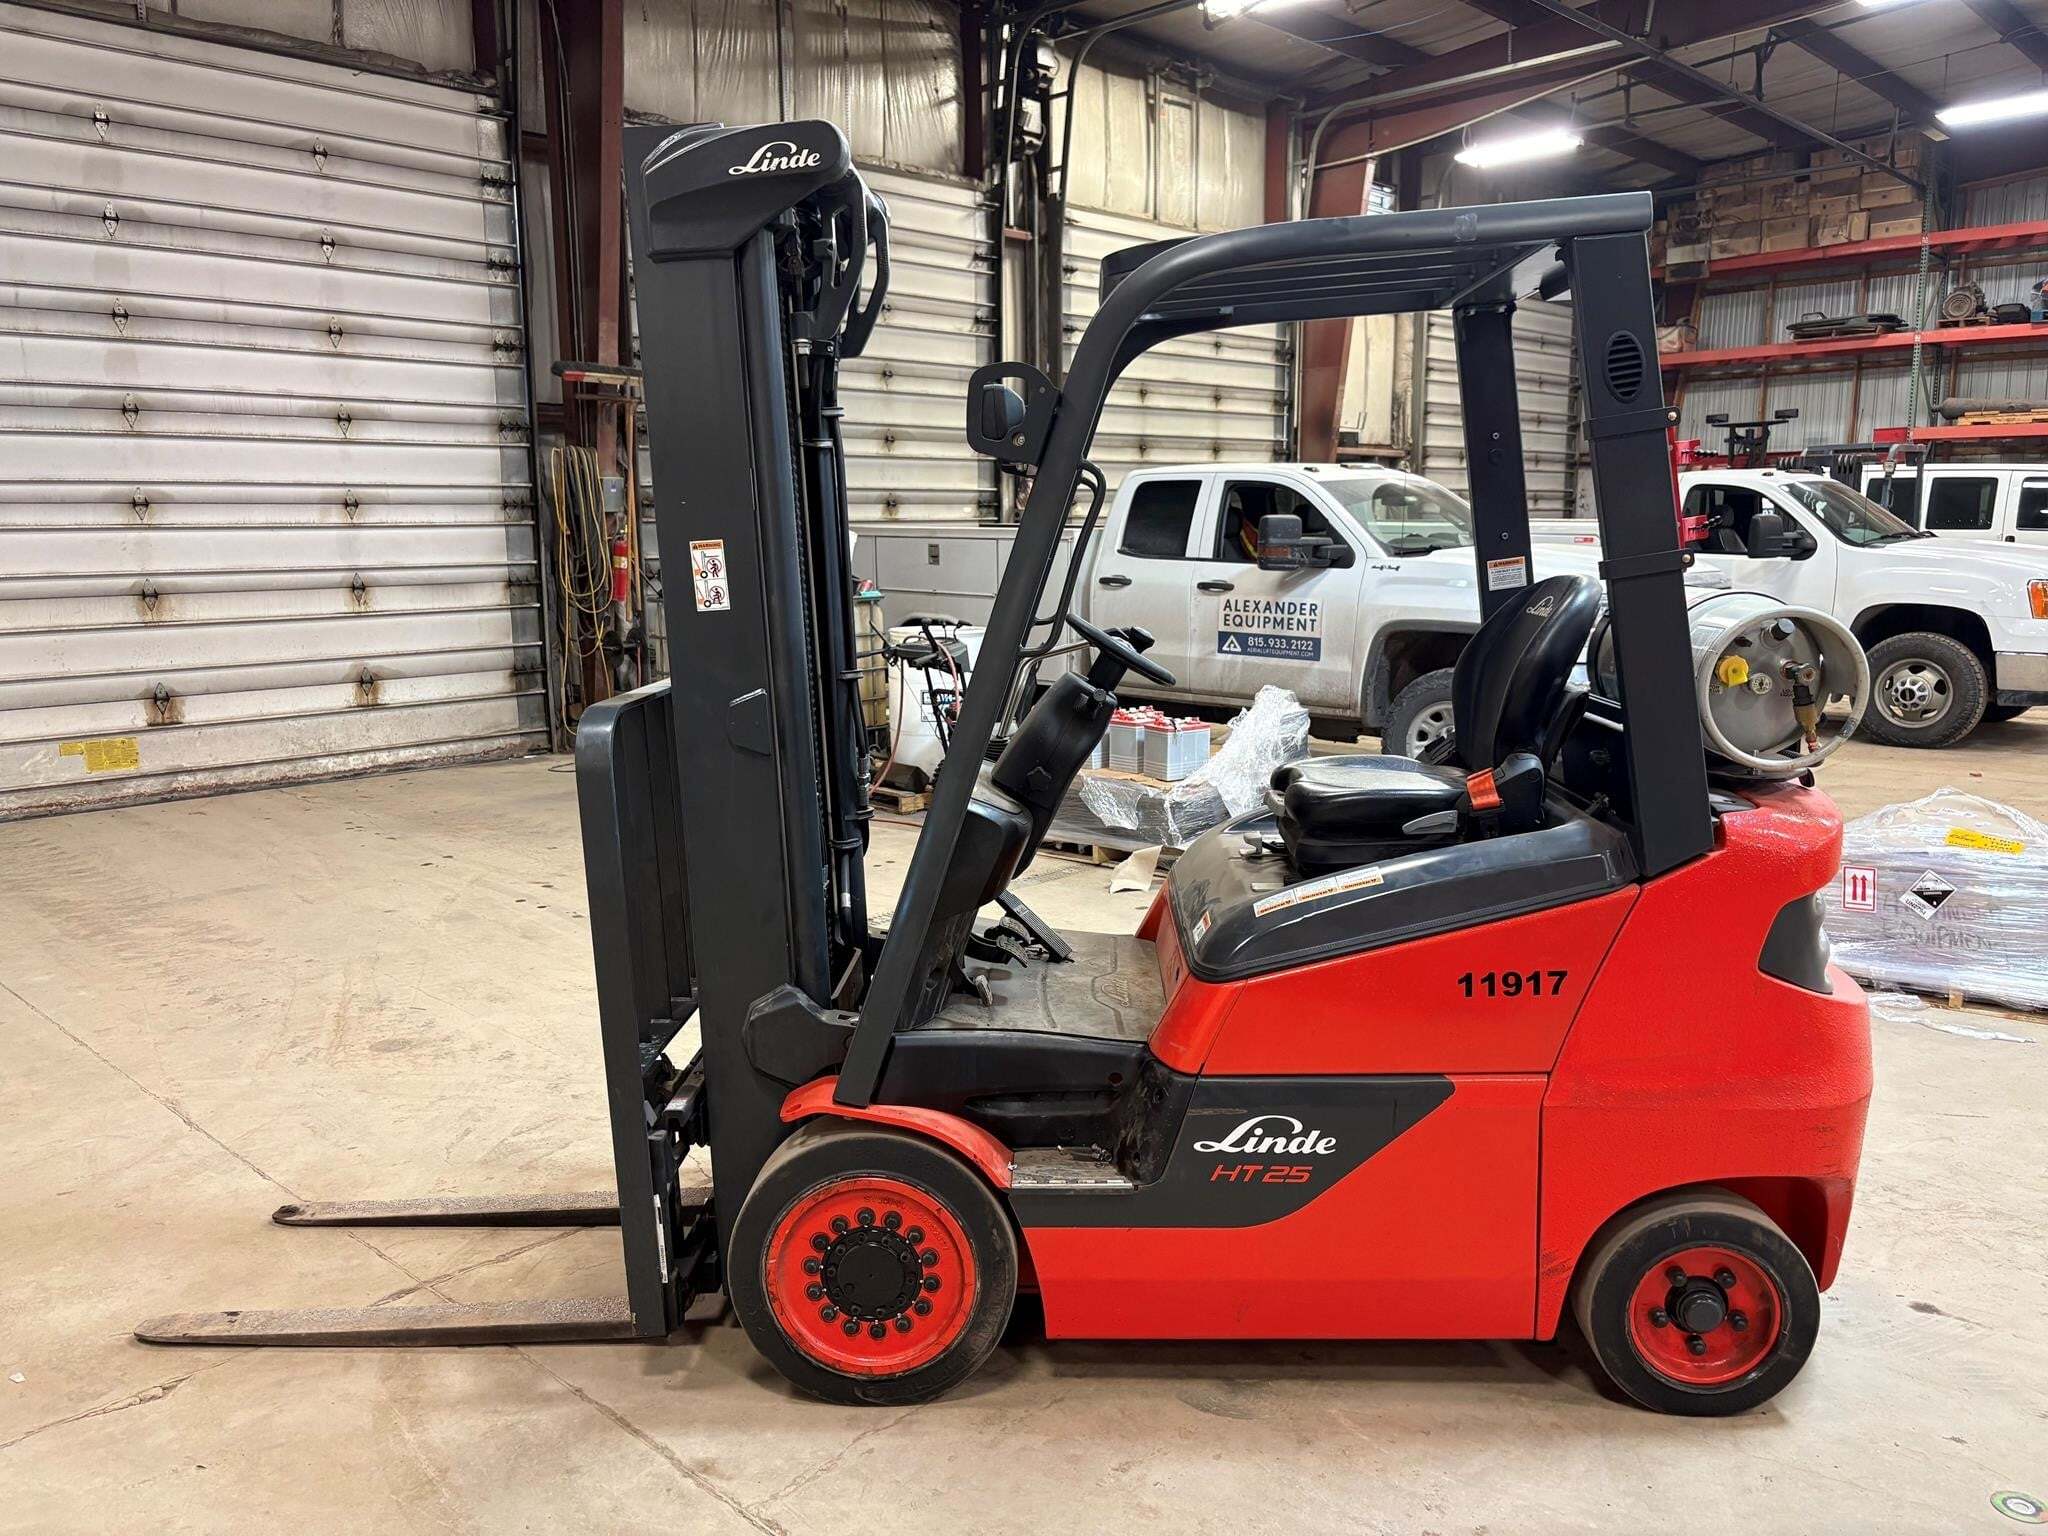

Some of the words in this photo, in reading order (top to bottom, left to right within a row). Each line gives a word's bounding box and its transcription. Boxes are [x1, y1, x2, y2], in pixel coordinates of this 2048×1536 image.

[729, 141, 822, 175] Linde
[1223, 598, 1318, 617] ALEXANDER
[1223, 613, 1317, 632] EQUIPMENT
[1457, 970, 1569, 998] 11917
[1193, 1114, 1337, 1156] Linde
